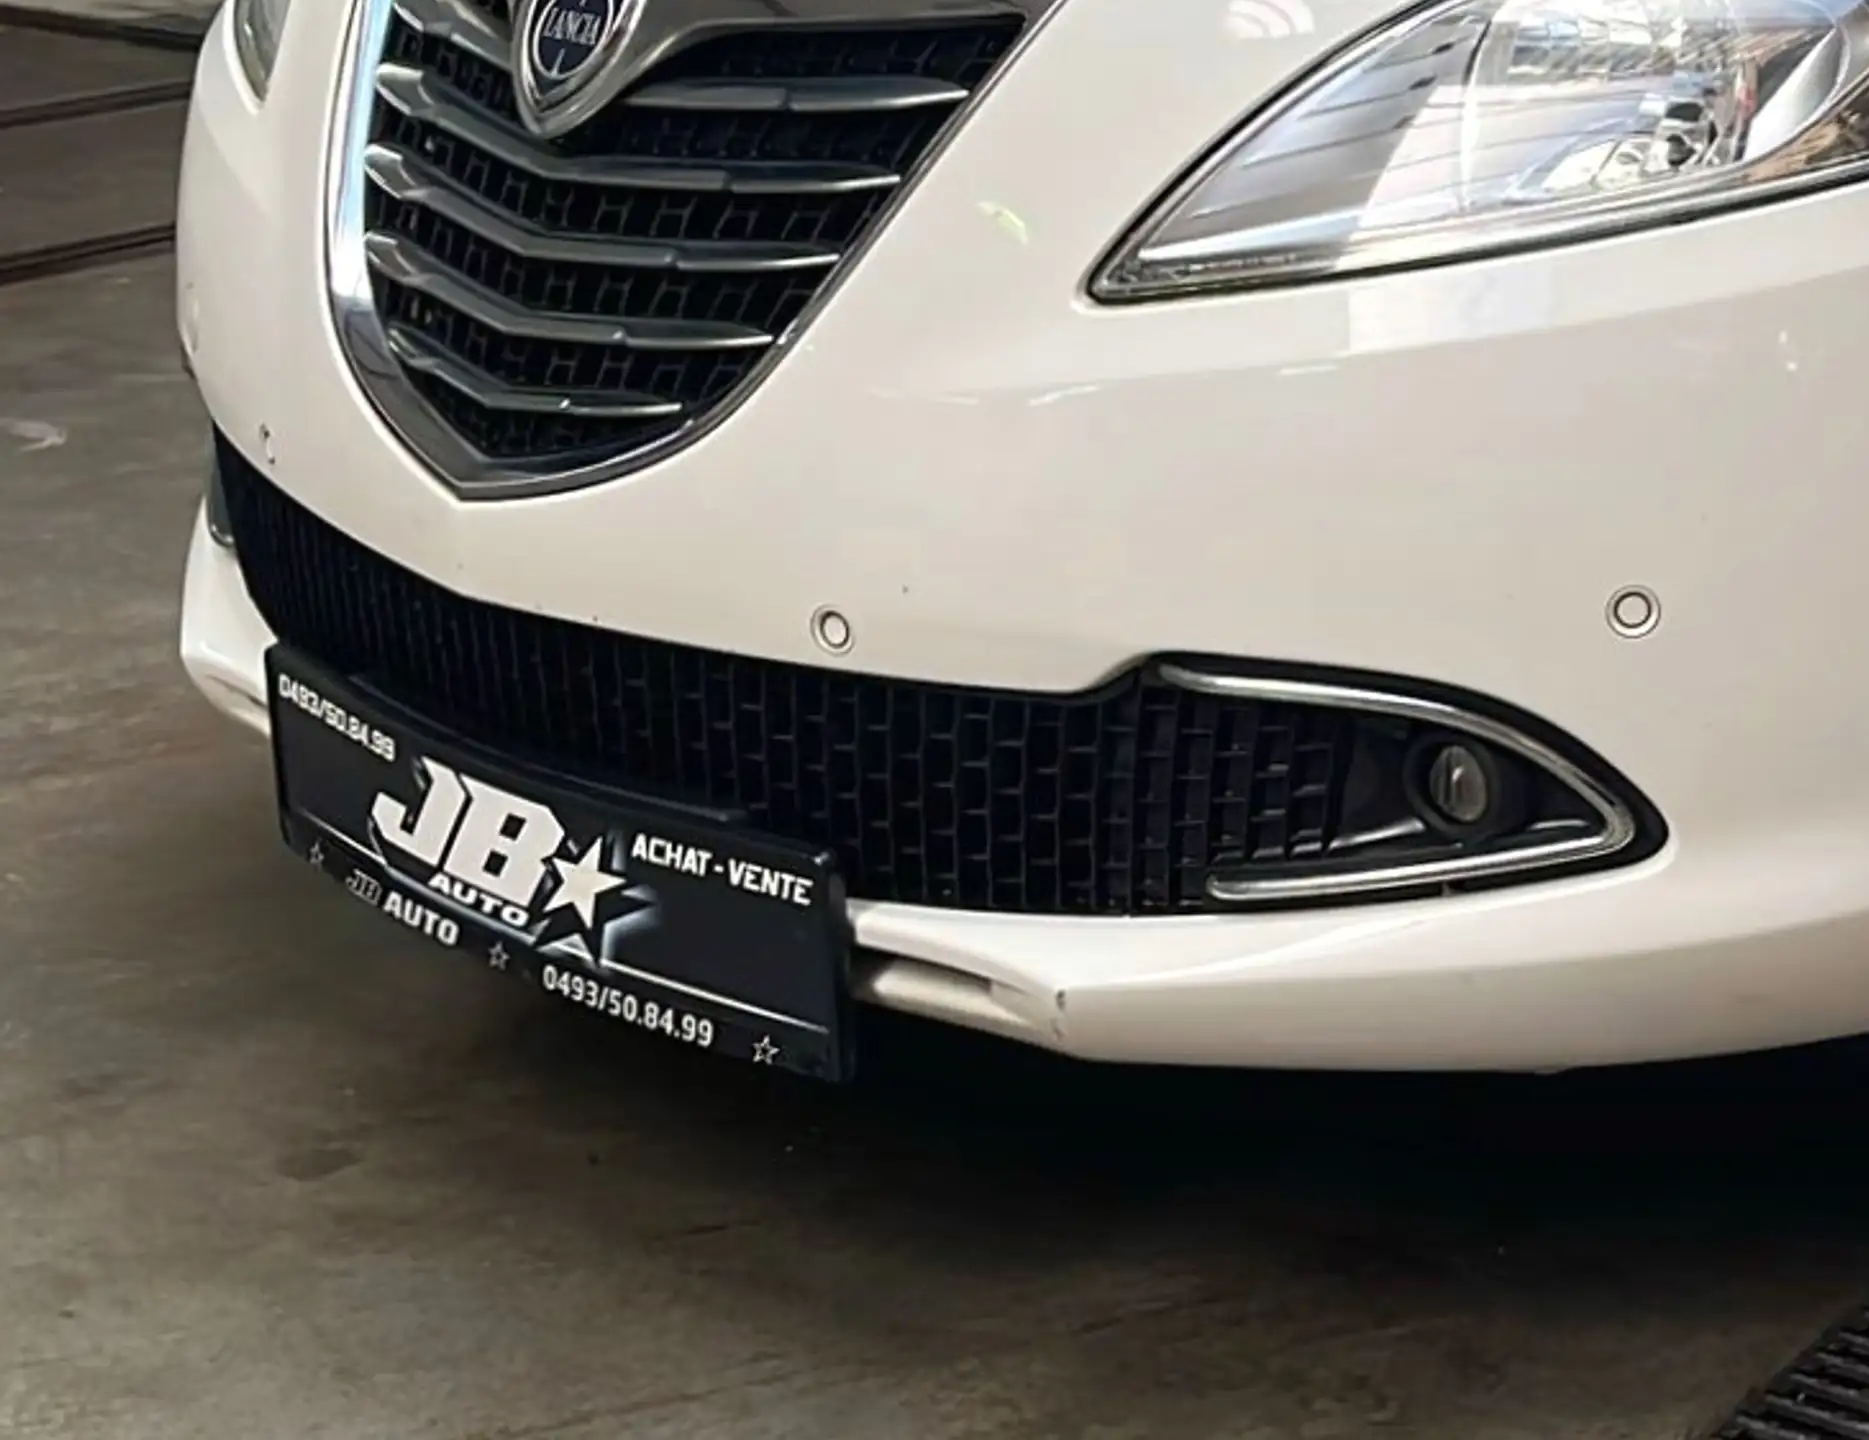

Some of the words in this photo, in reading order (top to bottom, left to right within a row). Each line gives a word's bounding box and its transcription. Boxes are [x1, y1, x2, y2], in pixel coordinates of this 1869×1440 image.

[543, 7, 602, 46] LANCIA
[370, 755, 566, 907] JB
[383, 891, 460, 947] AUTO
[427, 872, 530, 927] AUTO
[542, 965, 715, 1048] 0493/50.84.99
